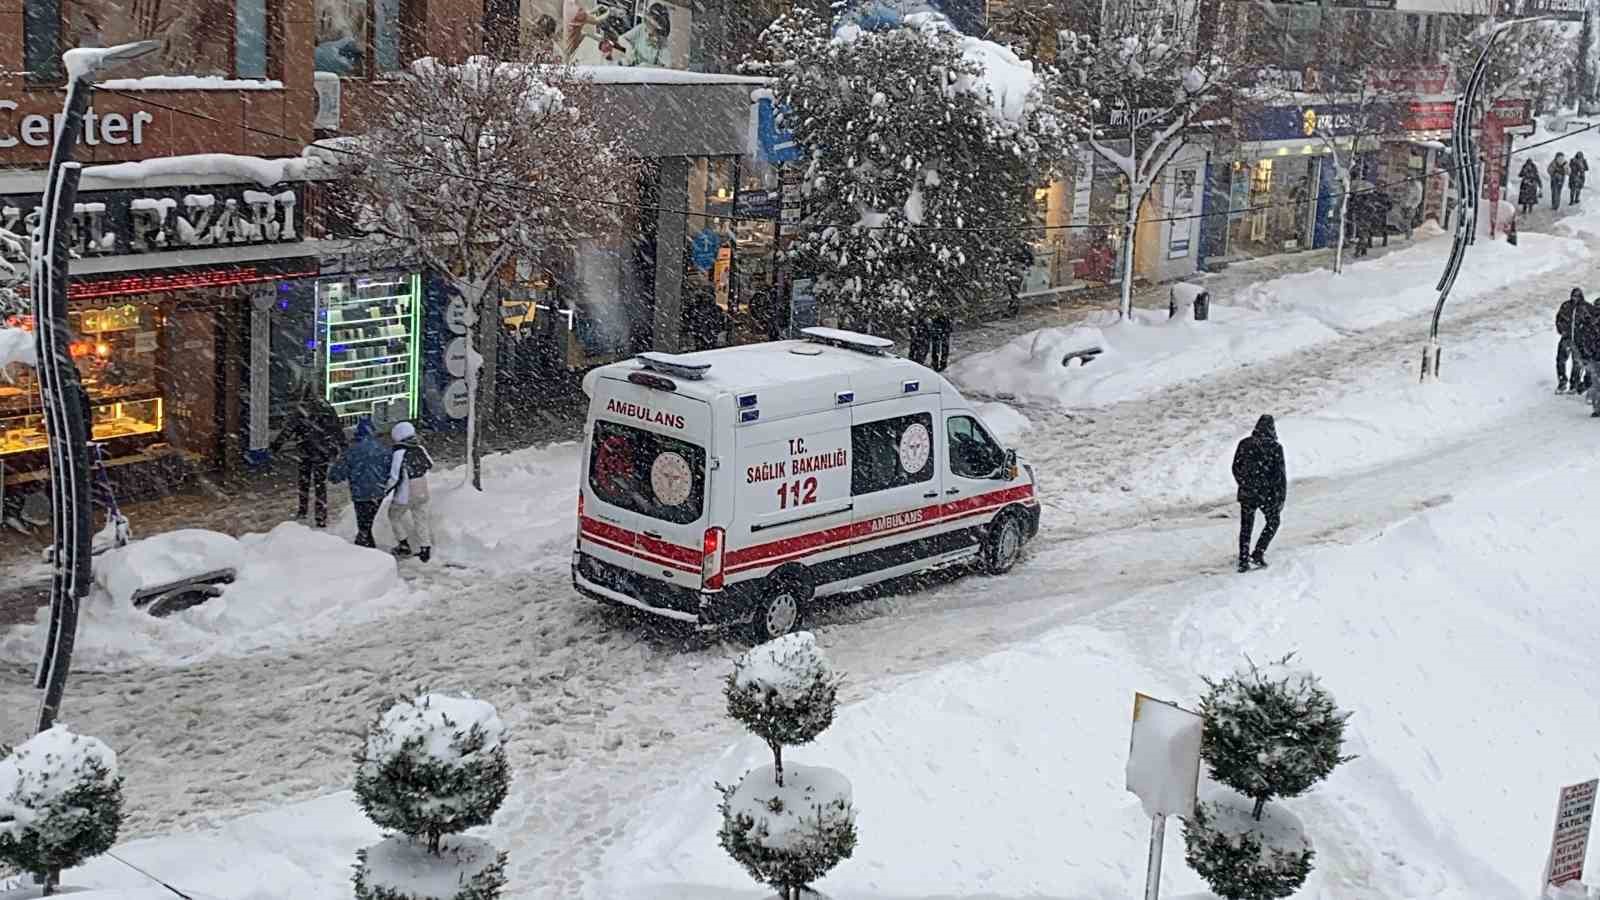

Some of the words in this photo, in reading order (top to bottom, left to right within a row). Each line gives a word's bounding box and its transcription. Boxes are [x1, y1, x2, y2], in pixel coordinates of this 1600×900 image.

[606, 398, 685, 430] AMBULANS
[746, 462, 786, 484] SAĞLIK
[791, 448, 847, 476] BAKANLIĞI
[777, 476, 818, 510] 112
[871, 509, 924, 533] AMBULANS
